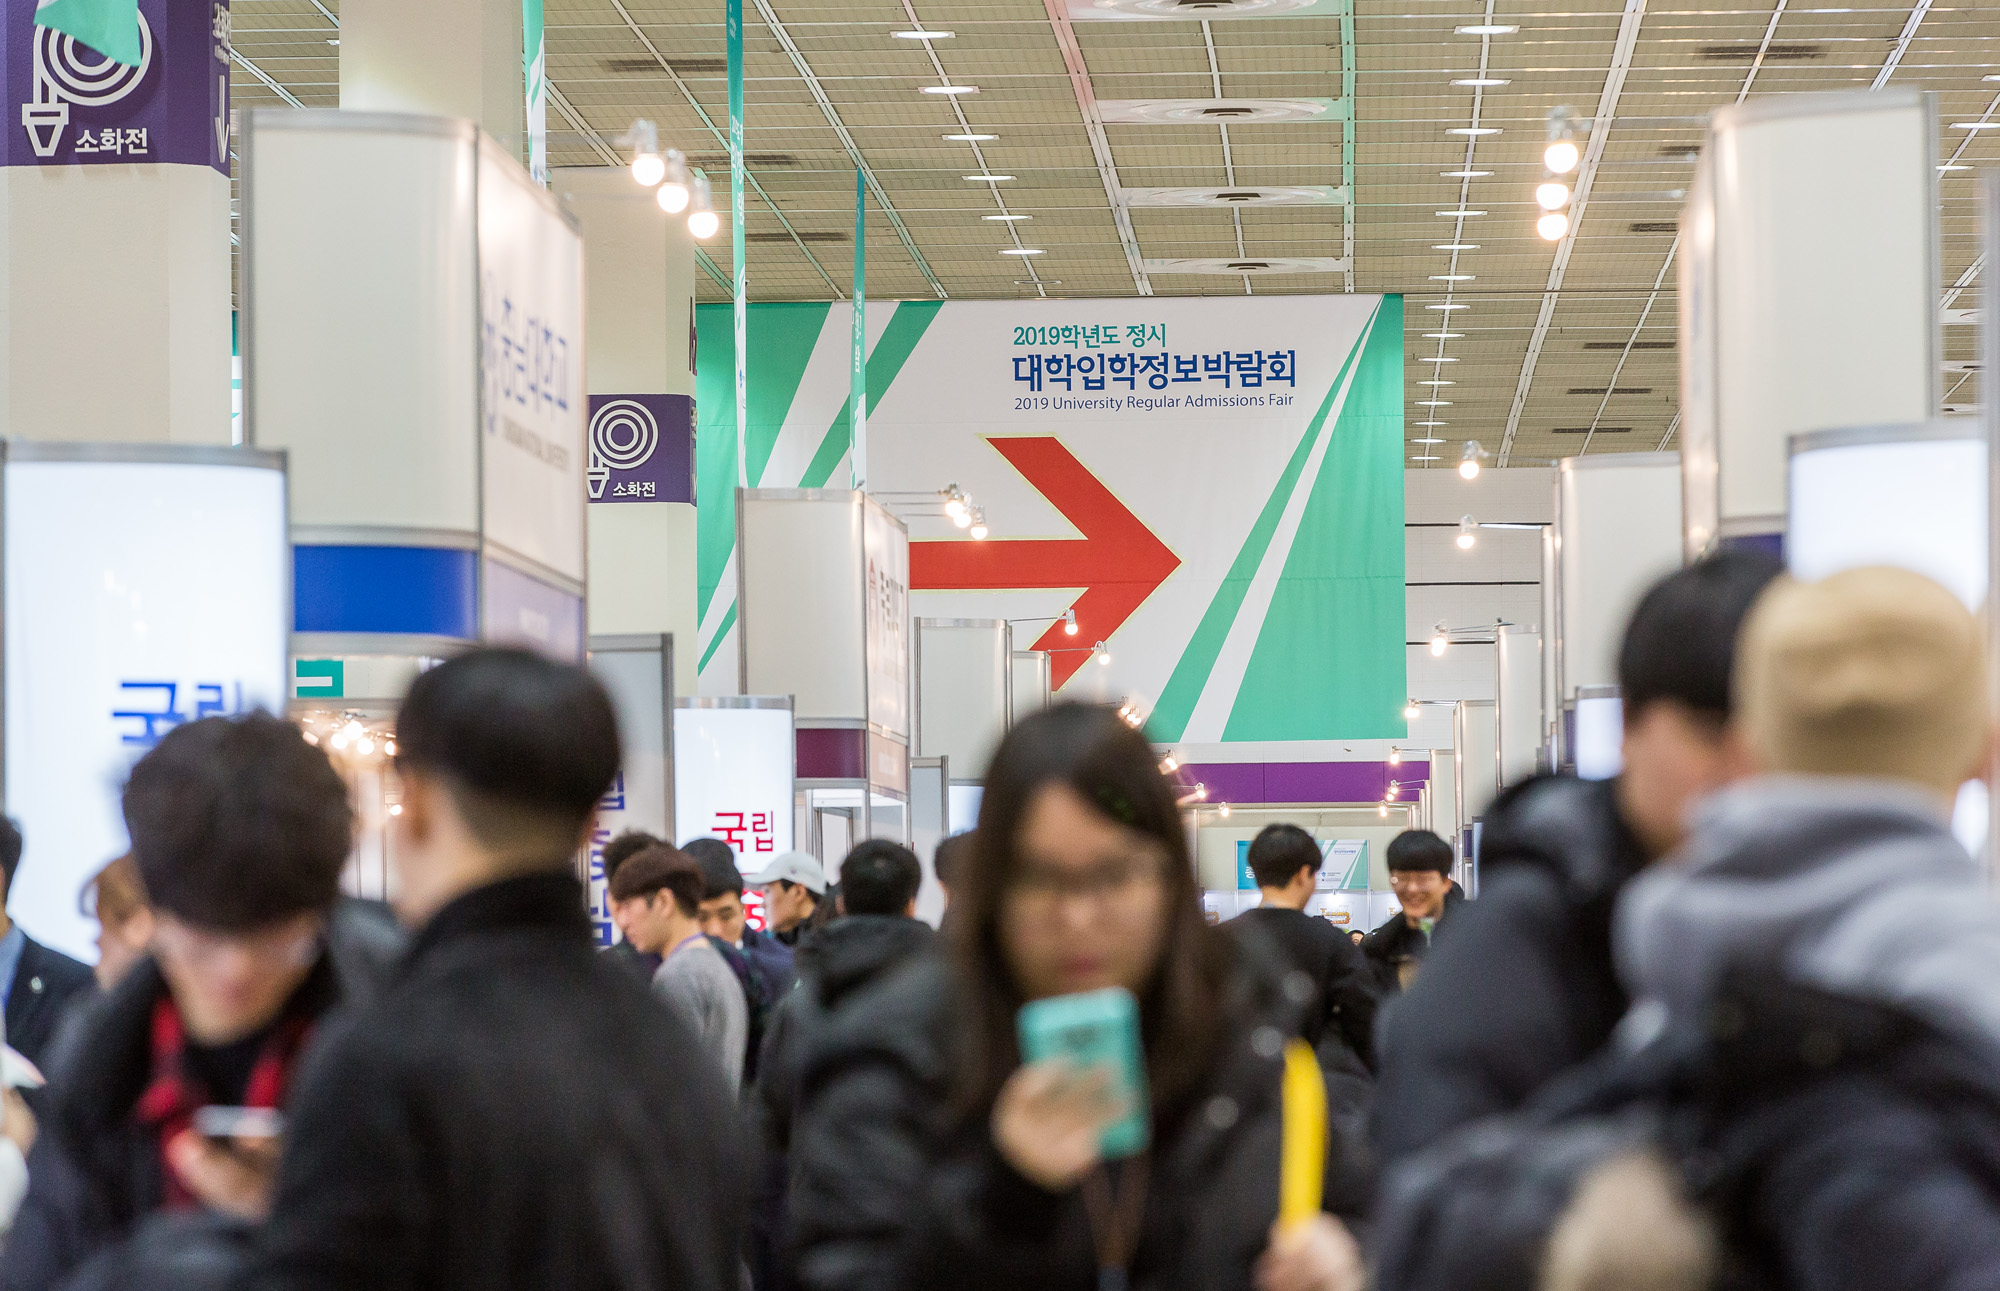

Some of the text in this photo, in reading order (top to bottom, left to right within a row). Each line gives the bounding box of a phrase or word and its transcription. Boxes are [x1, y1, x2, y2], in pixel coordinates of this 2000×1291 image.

[74, 127, 148, 155] 소화전
[1013, 323, 1166, 349] 2019학년도 정시
[1012, 350, 1296, 392] 대학입학정보박람회
[1015, 393, 1294, 412] 2019 University Regular Admissions Fair
[612, 481, 656, 498] 소화전
[711, 811, 774, 853] 국립
